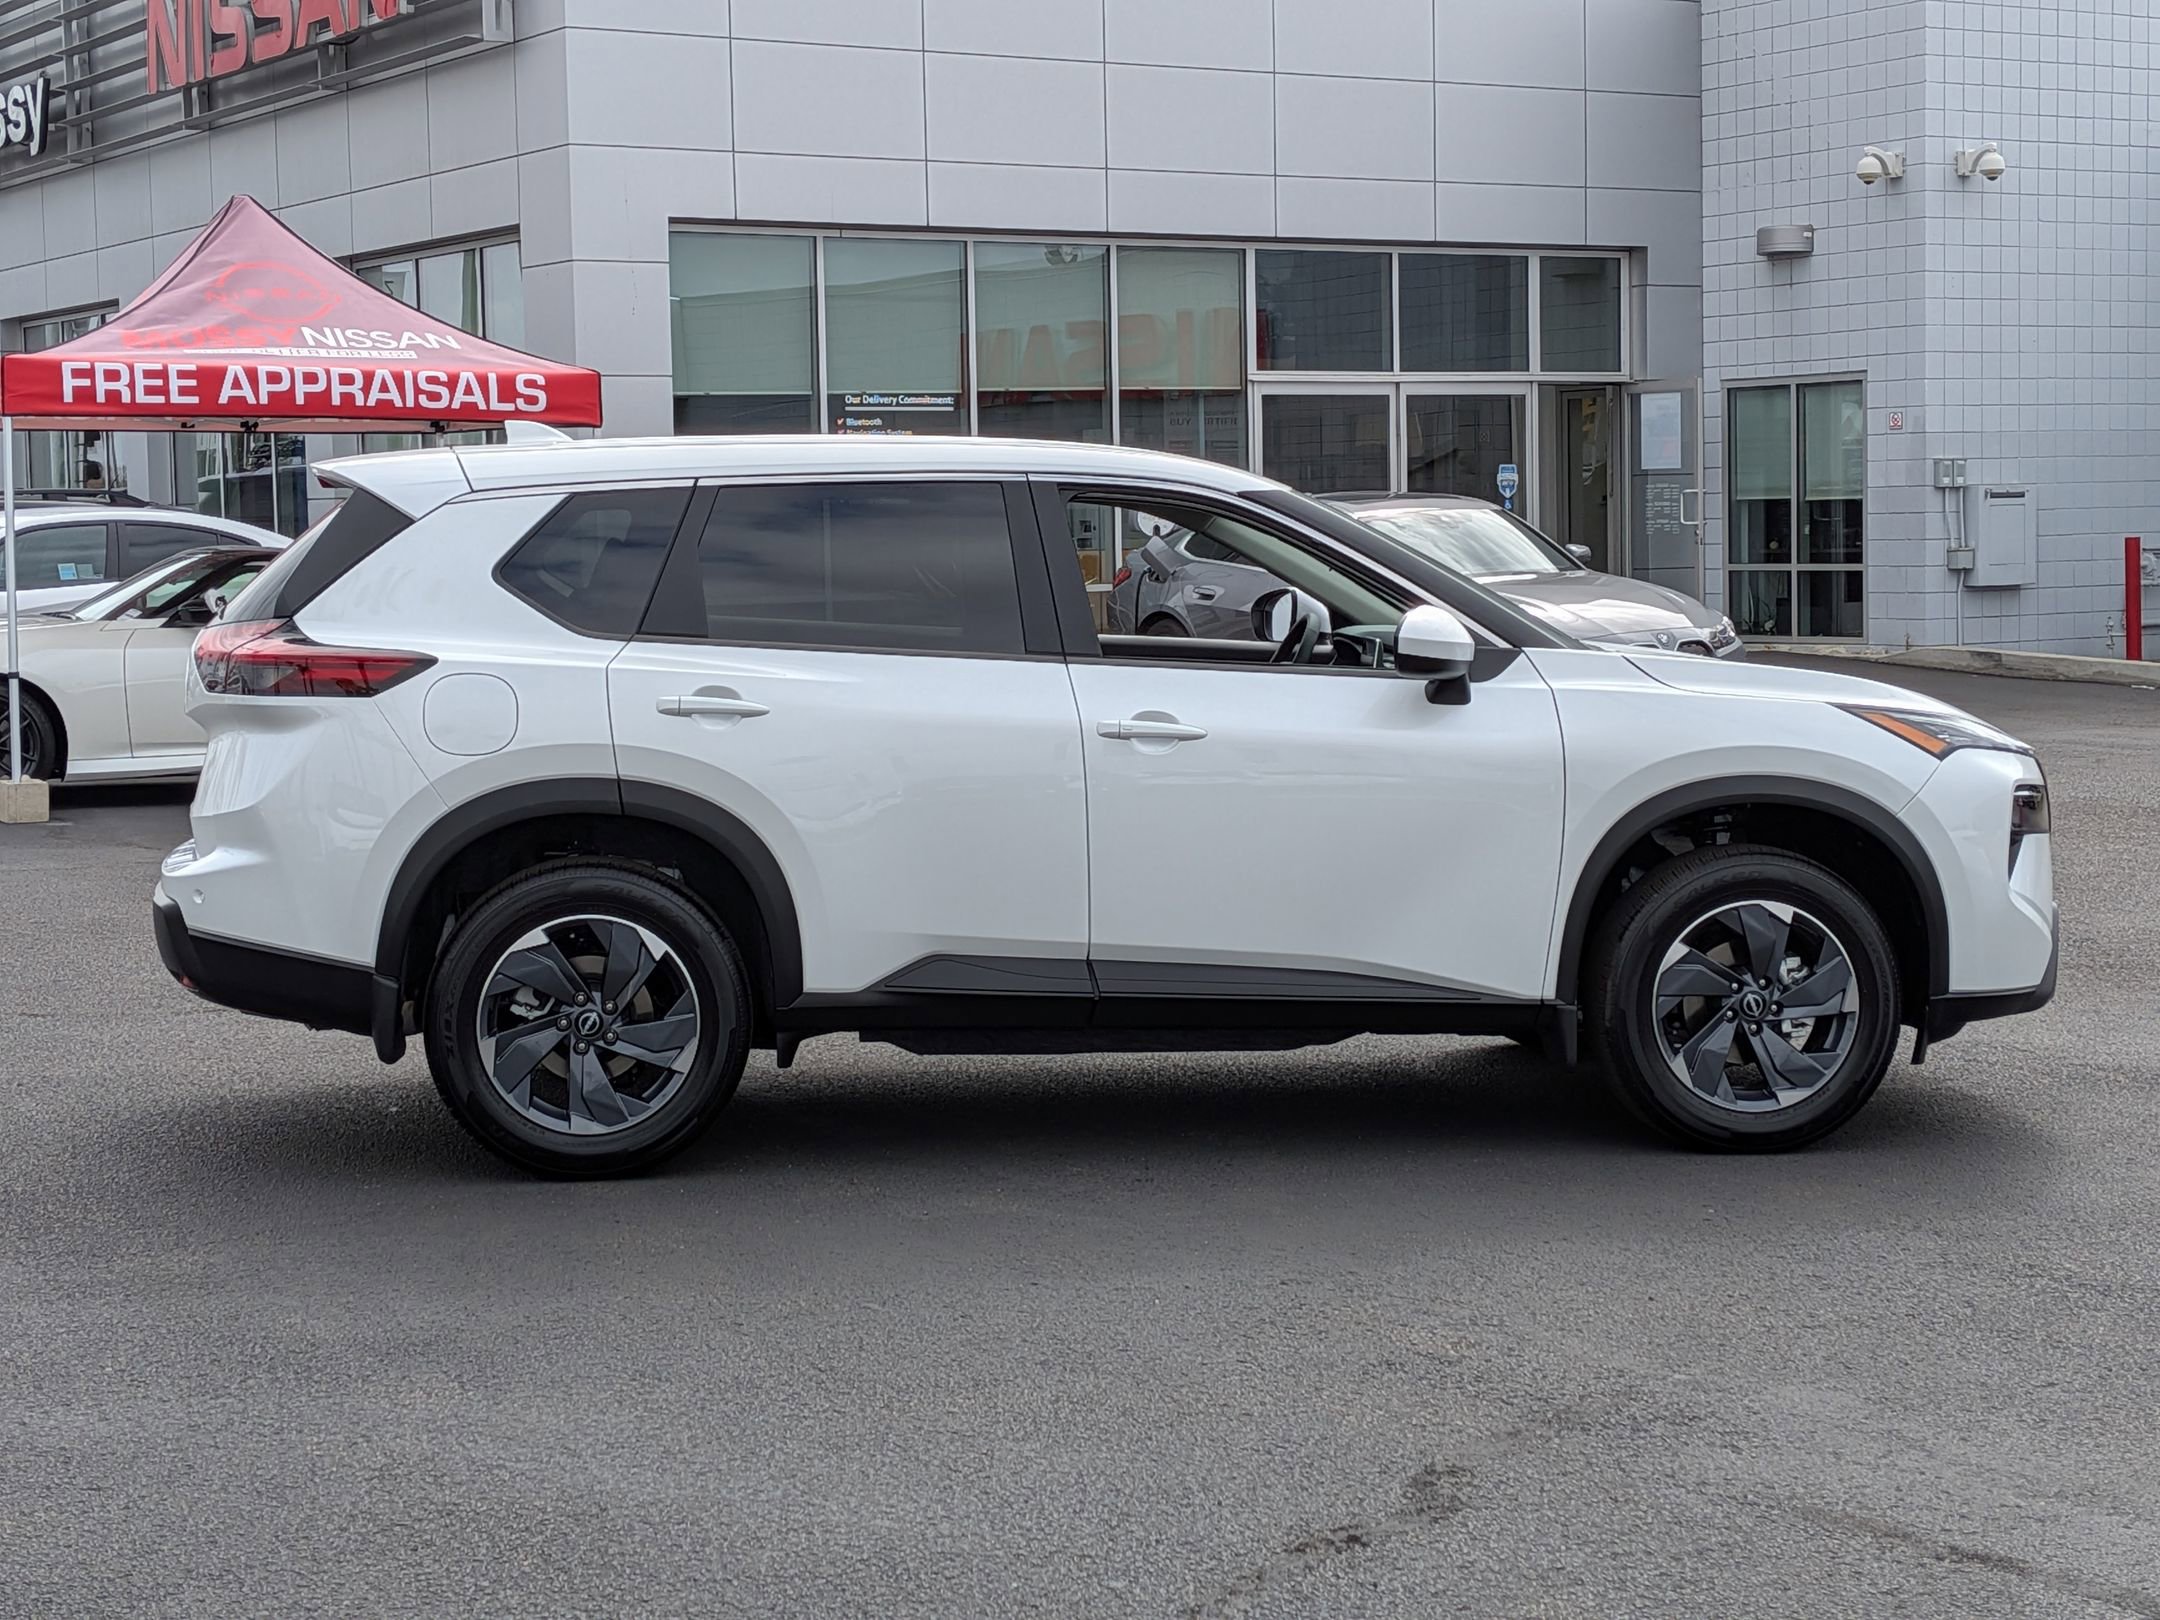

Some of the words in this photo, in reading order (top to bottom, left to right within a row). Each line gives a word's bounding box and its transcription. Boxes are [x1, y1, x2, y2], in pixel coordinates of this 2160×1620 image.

[301, 326, 462, 350] NISSAN
[62, 361, 200, 405] FREE
[217, 365, 547, 412] APPRAISALS
[845, 395, 861, 404] Our
[862, 395, 898, 406] Delivery
[898, 395, 955, 405] Commitment:
[846, 418, 882, 426] Bluetooth
